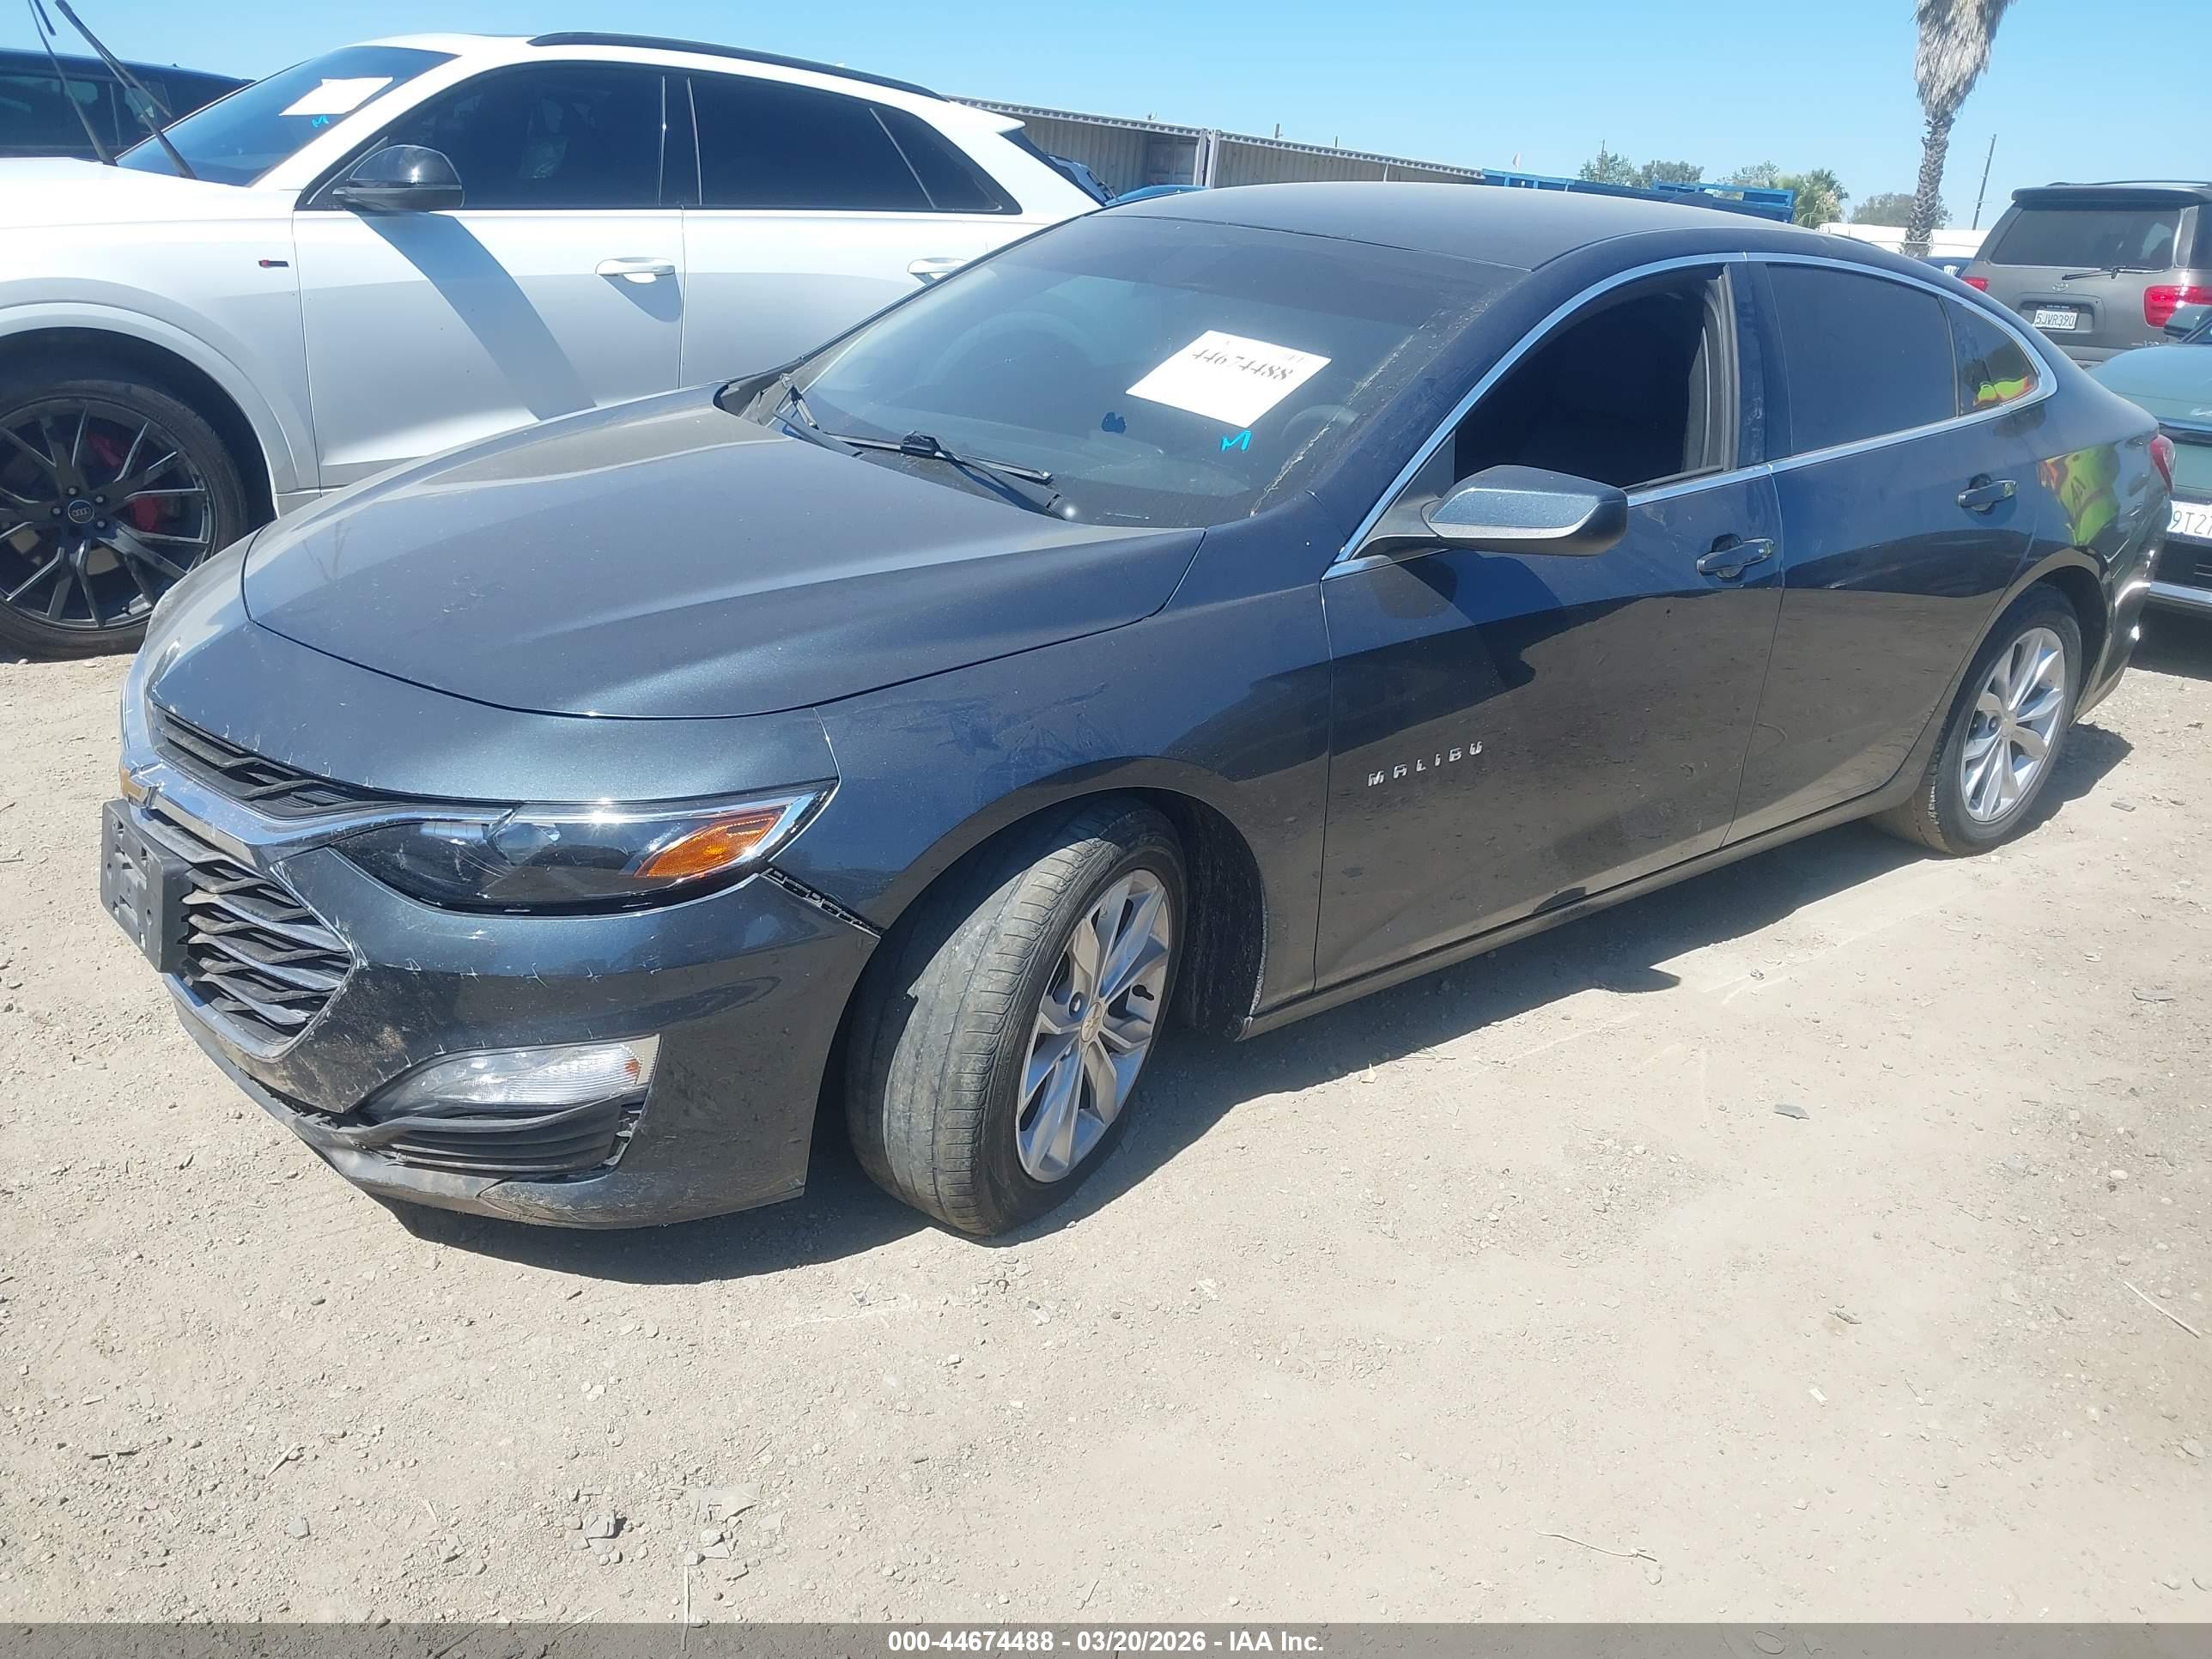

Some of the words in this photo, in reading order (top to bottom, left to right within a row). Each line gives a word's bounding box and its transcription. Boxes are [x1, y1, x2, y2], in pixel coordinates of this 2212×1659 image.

[2036, 313, 2075, 326] 5JVR390
[1192, 349, 1294, 380] 44674488
[1220, 429, 1252, 452] M
[1367, 741, 1483, 787] MALIBU
